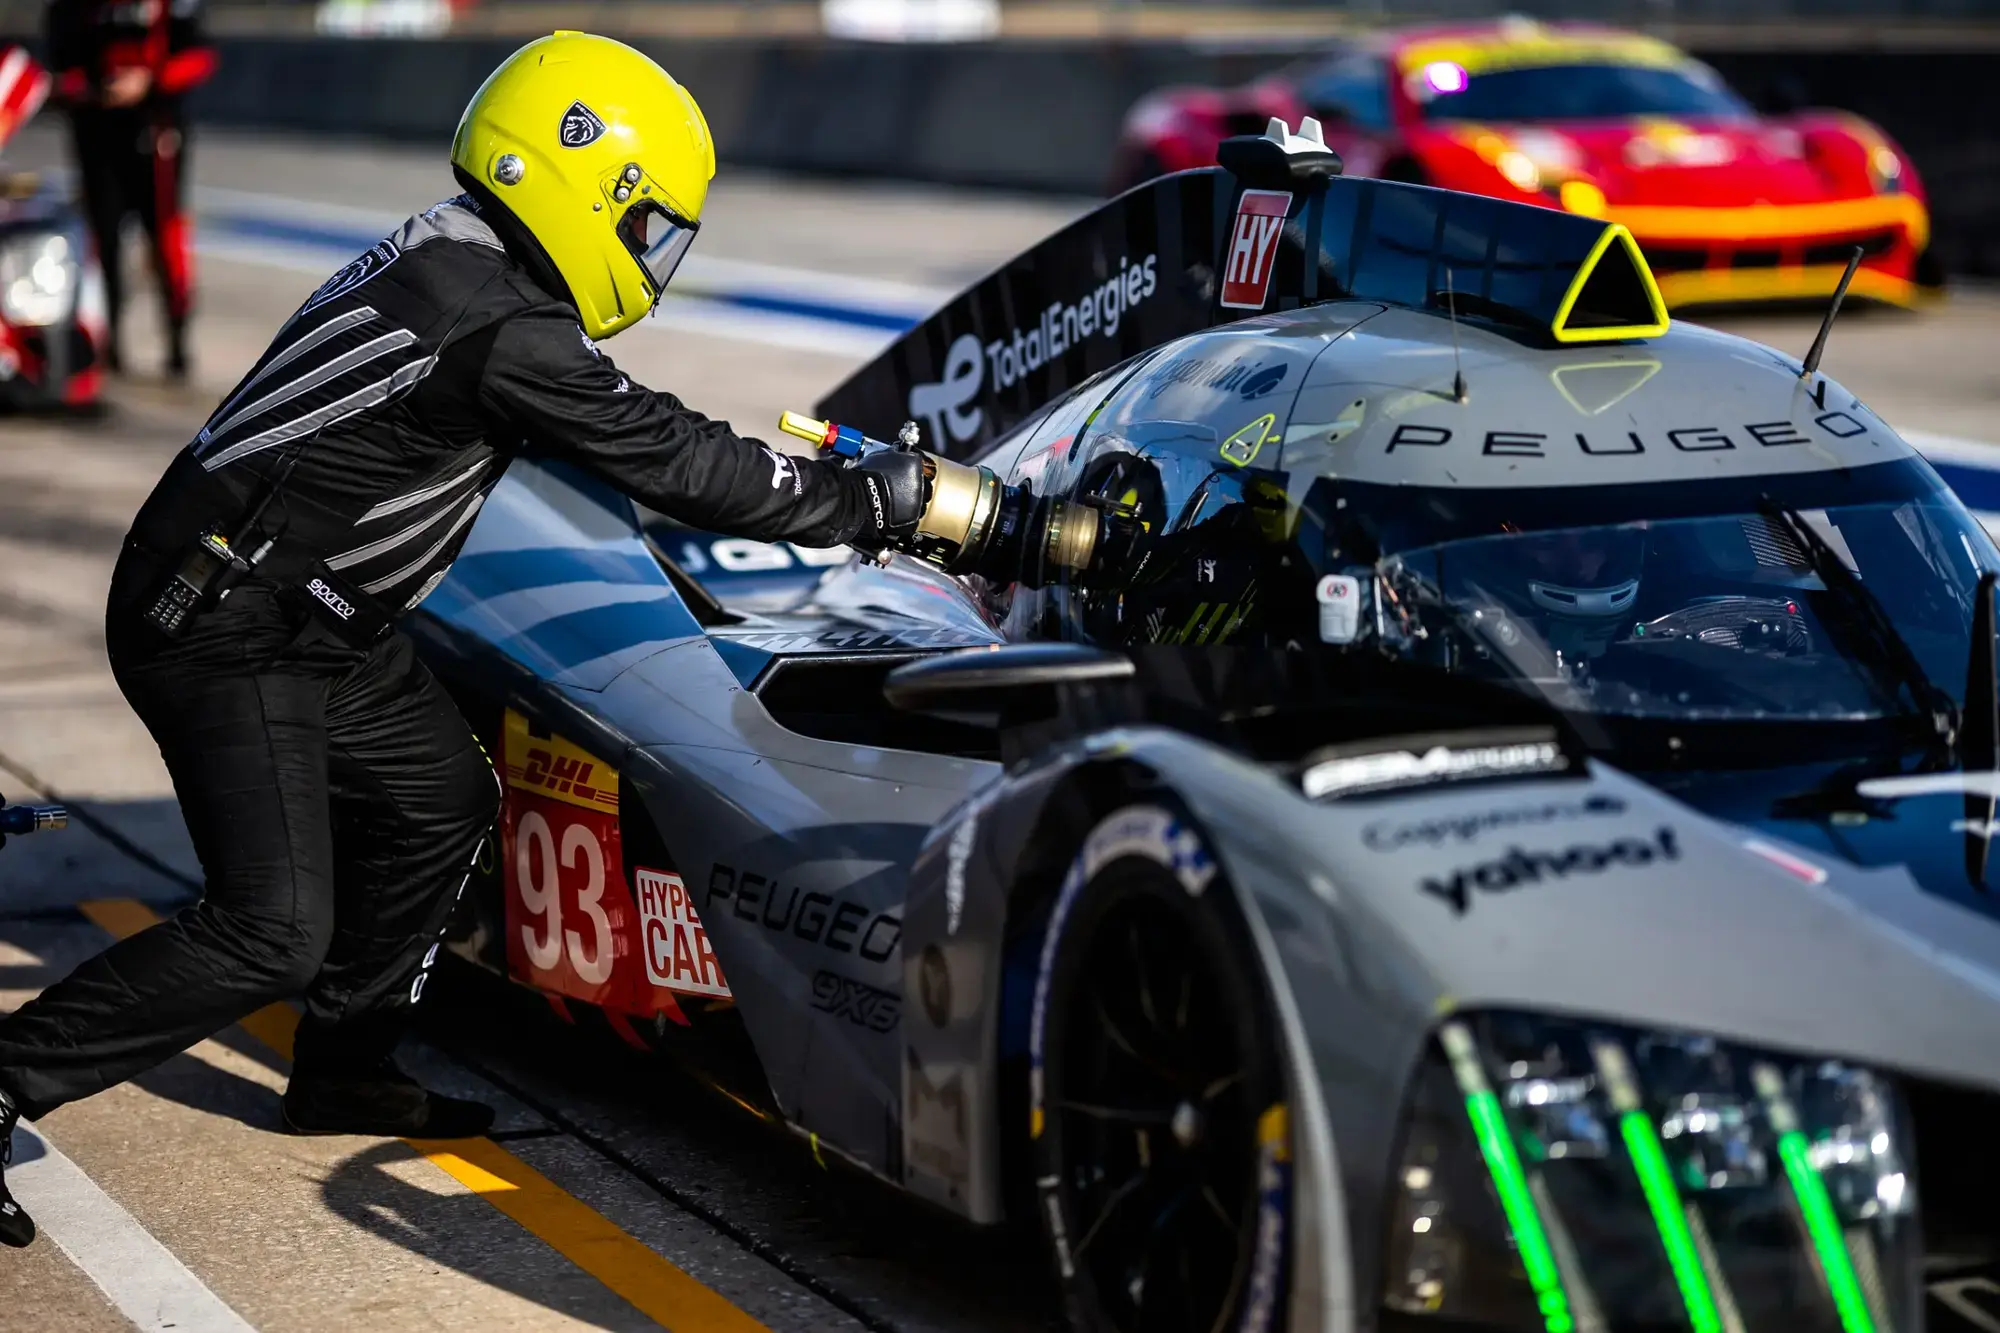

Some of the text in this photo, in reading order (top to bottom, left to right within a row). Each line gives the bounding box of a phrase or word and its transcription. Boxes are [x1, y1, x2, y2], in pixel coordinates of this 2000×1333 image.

[1228, 214, 1281, 284] HY
[986, 254, 1156, 393] TotalEnergies
[1386, 409, 1869, 457] PEUGEO
[867, 477, 884, 529] sparco
[306, 579, 355, 620] sparco
[523, 748, 596, 800] DHL
[516, 811, 614, 985] 93
[641, 878, 700, 924] HYPE
[707, 863, 901, 964] PEUGEO
[646, 917, 727, 988] CAR
